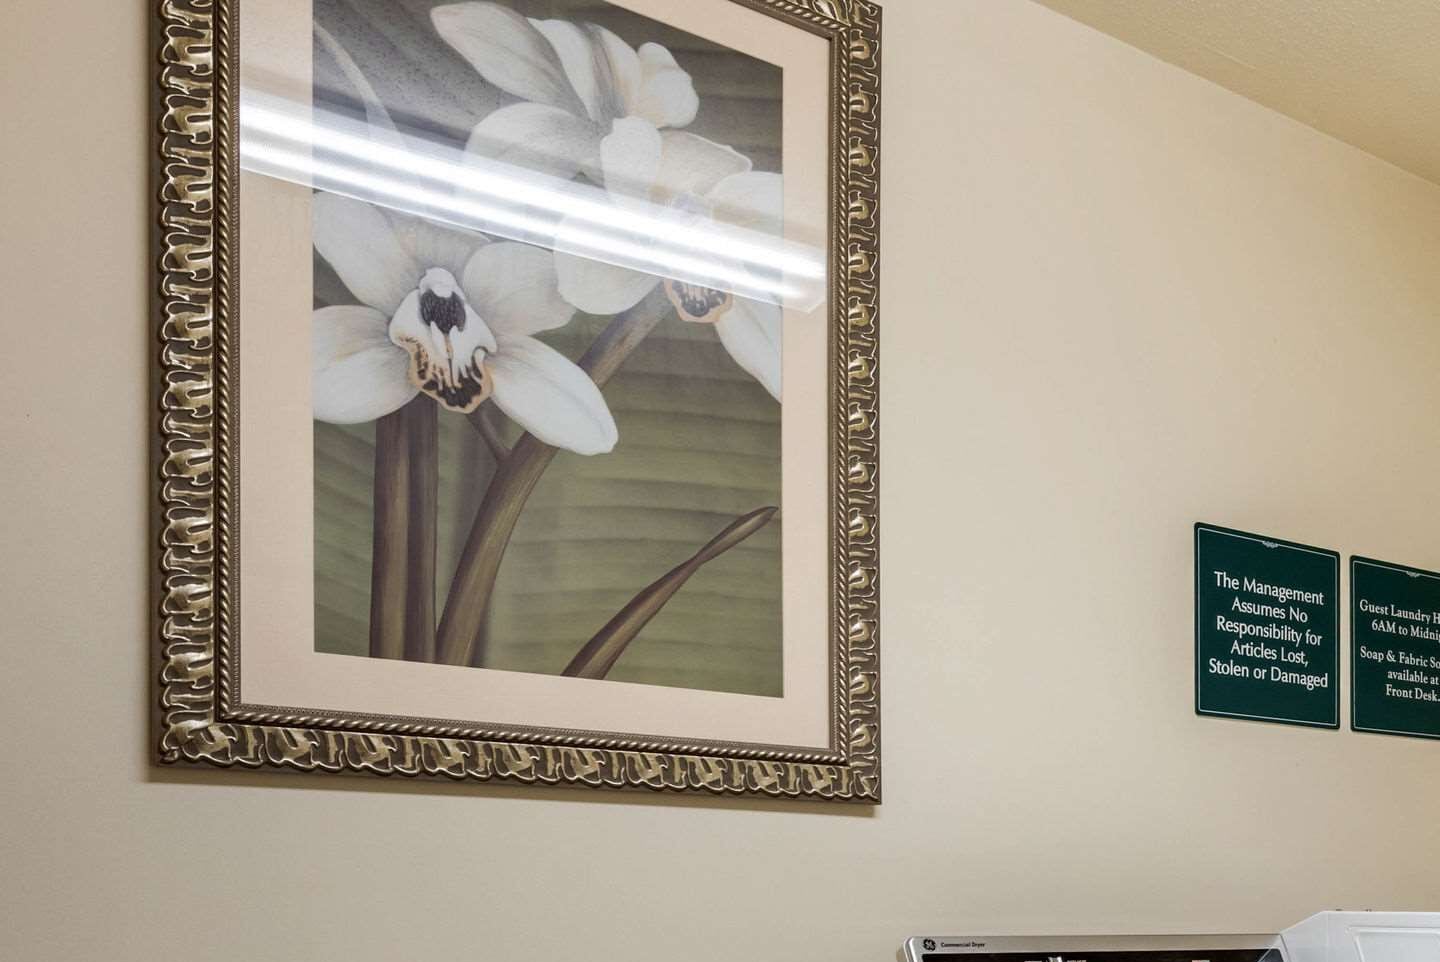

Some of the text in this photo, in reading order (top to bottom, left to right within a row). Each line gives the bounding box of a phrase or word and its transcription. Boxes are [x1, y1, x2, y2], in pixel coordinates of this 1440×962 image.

[1214, 570, 1325, 605] The Management
[1231, 596, 1308, 623] Assumes No
[1360, 599, 1389, 616] Guest
[1390, 604, 1431, 625] Laundry
[1216, 615, 1322, 647] Responsibility for
[1371, 619, 1396, 634] 6AM
[1398, 624, 1408, 636] to
[1230, 639, 1309, 667] Articles Lost,
[1360, 646, 1385, 662] Soap
[1386, 650, 1397, 663] &
[1398, 651, 1428, 667] Fabric
[1208, 658, 1328, 690] Stolen or Damaged
[1387, 669, 1440, 686] available at
[1385, 683, 1440, 702] Front Desk.
